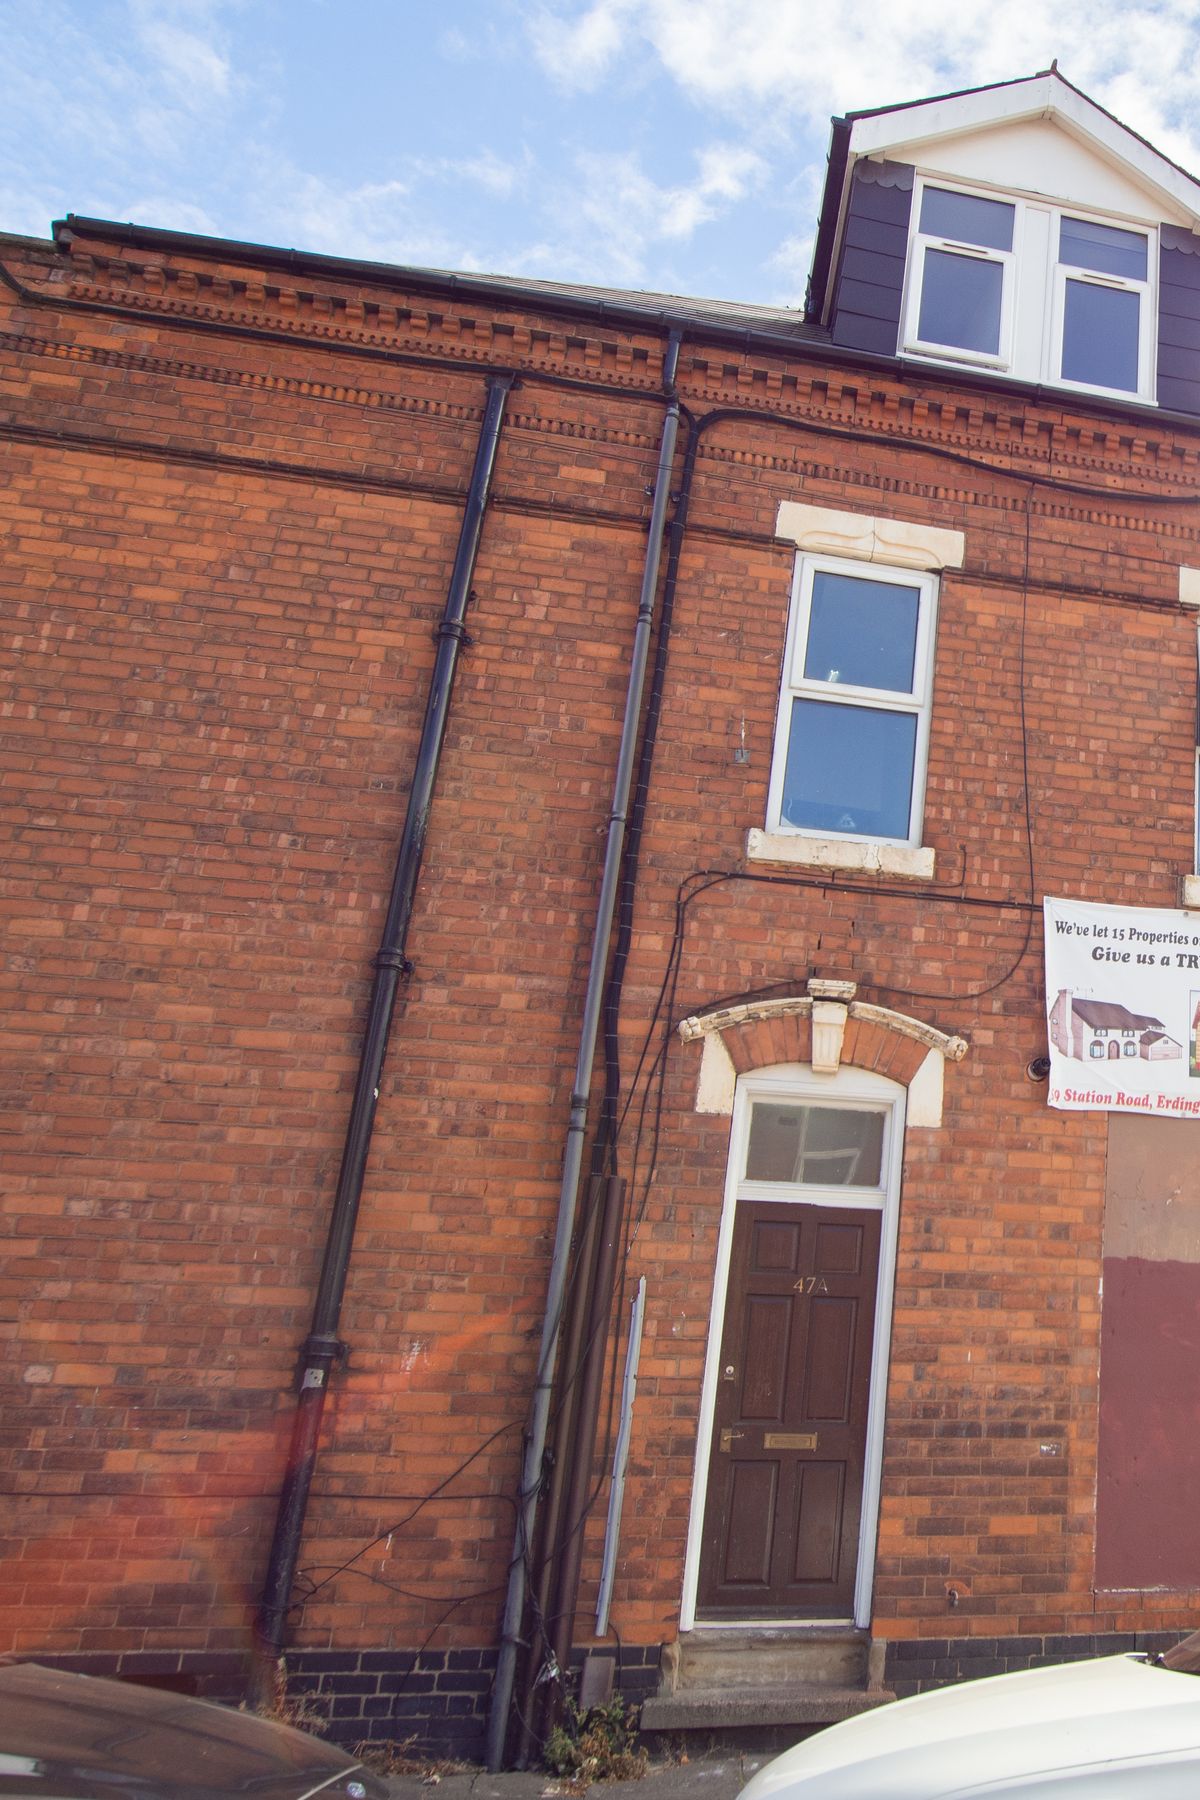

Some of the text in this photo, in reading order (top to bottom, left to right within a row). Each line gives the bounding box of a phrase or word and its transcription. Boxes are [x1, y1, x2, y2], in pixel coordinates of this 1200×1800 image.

[1055, 920, 1089, 936] We've
[1093, 924, 1108, 938] let
[1112, 928, 1125, 940] 15
[1128, 927, 1189, 946] Properties
[1091, 946, 1131, 963] Give
[1136, 953, 1155, 966] us
[1160, 955, 1170, 967] a
[1064, 1088, 1112, 1105] Station
[1115, 1091, 1152, 1109] Road,
[793, 1277, 828, 1294] 47A
